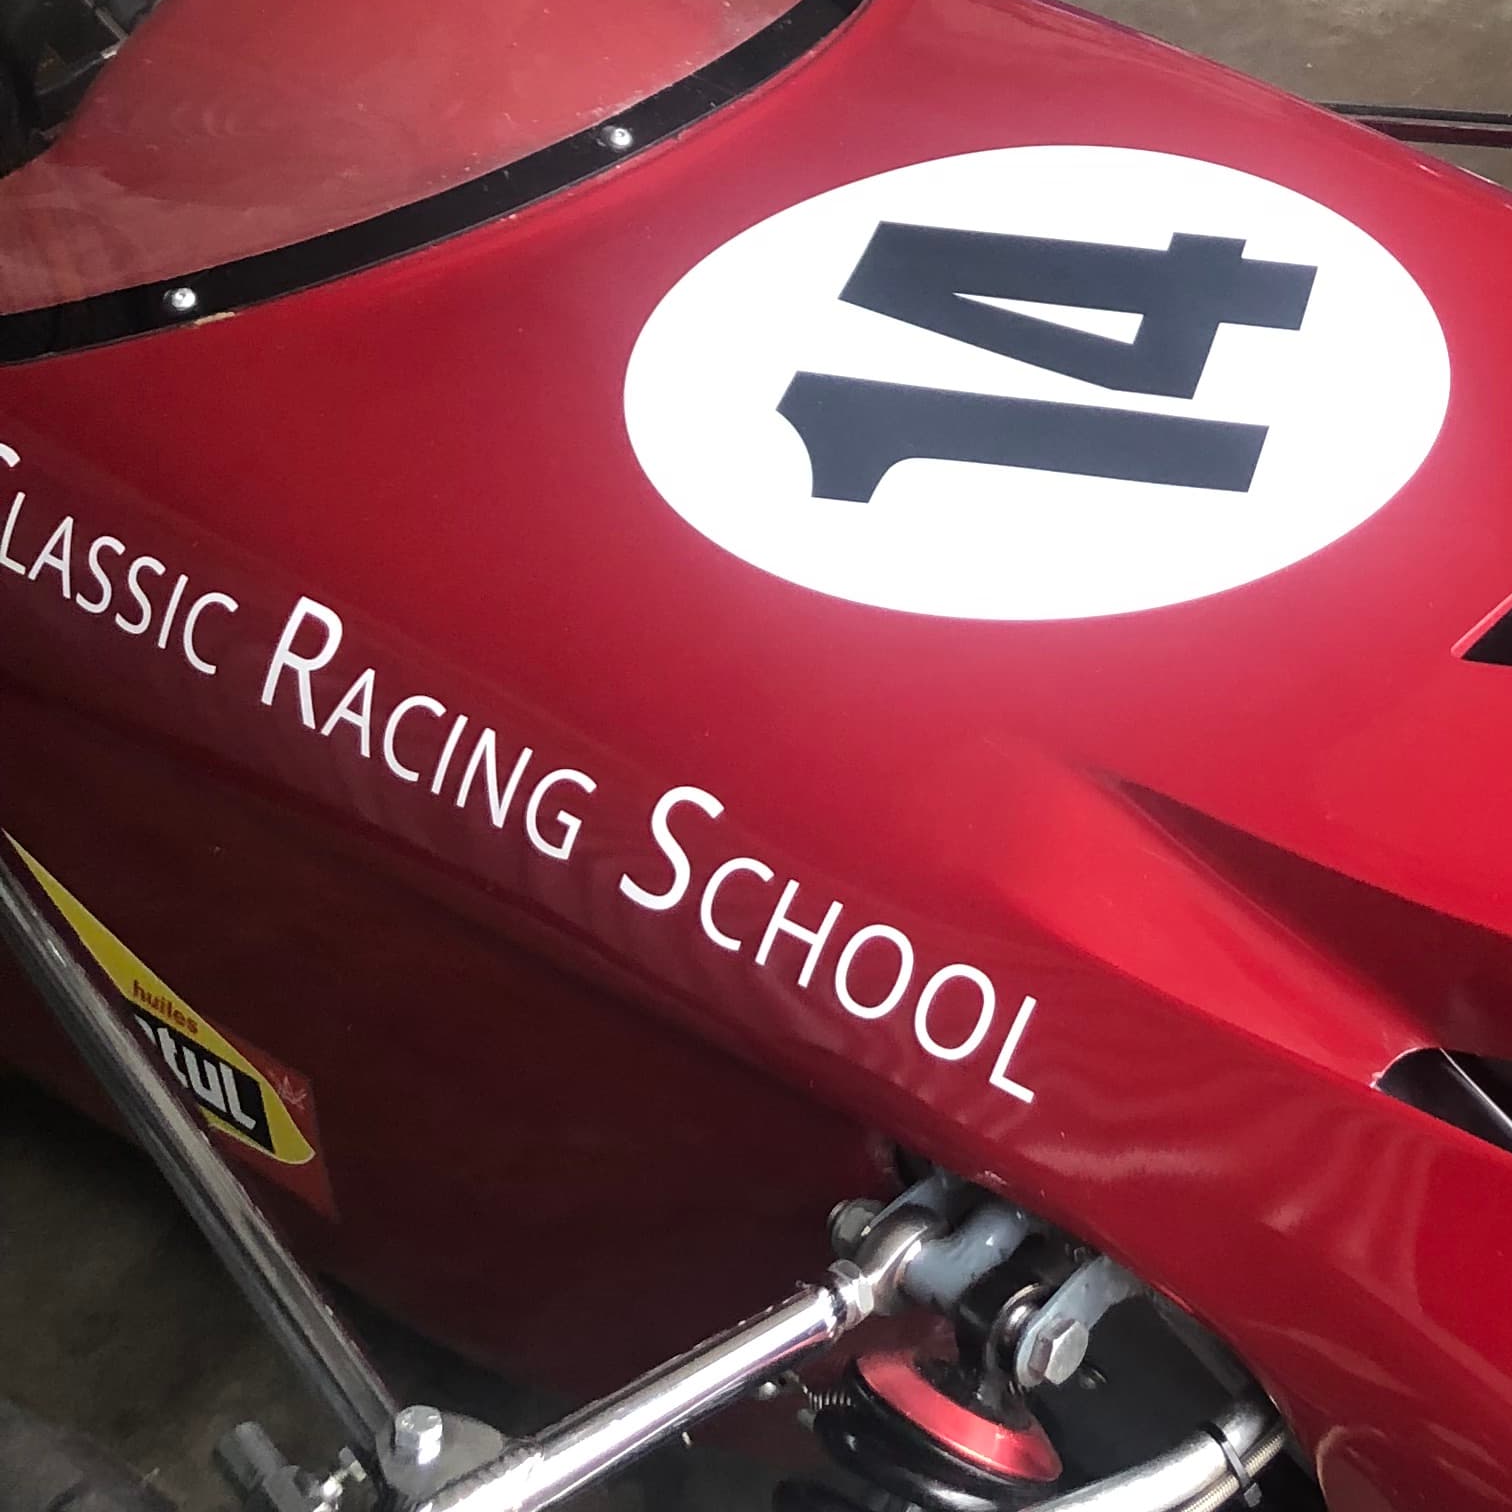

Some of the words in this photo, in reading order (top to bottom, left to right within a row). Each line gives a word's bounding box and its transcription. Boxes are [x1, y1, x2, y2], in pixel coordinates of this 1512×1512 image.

[775, 220, 1319, 504] 14
[260, 594, 598, 861] RACING
[619, 784, 1039, 1104] SCHOOL
[132, 978, 199, 1036] huiles
[134, 1013, 257, 1130] tul
